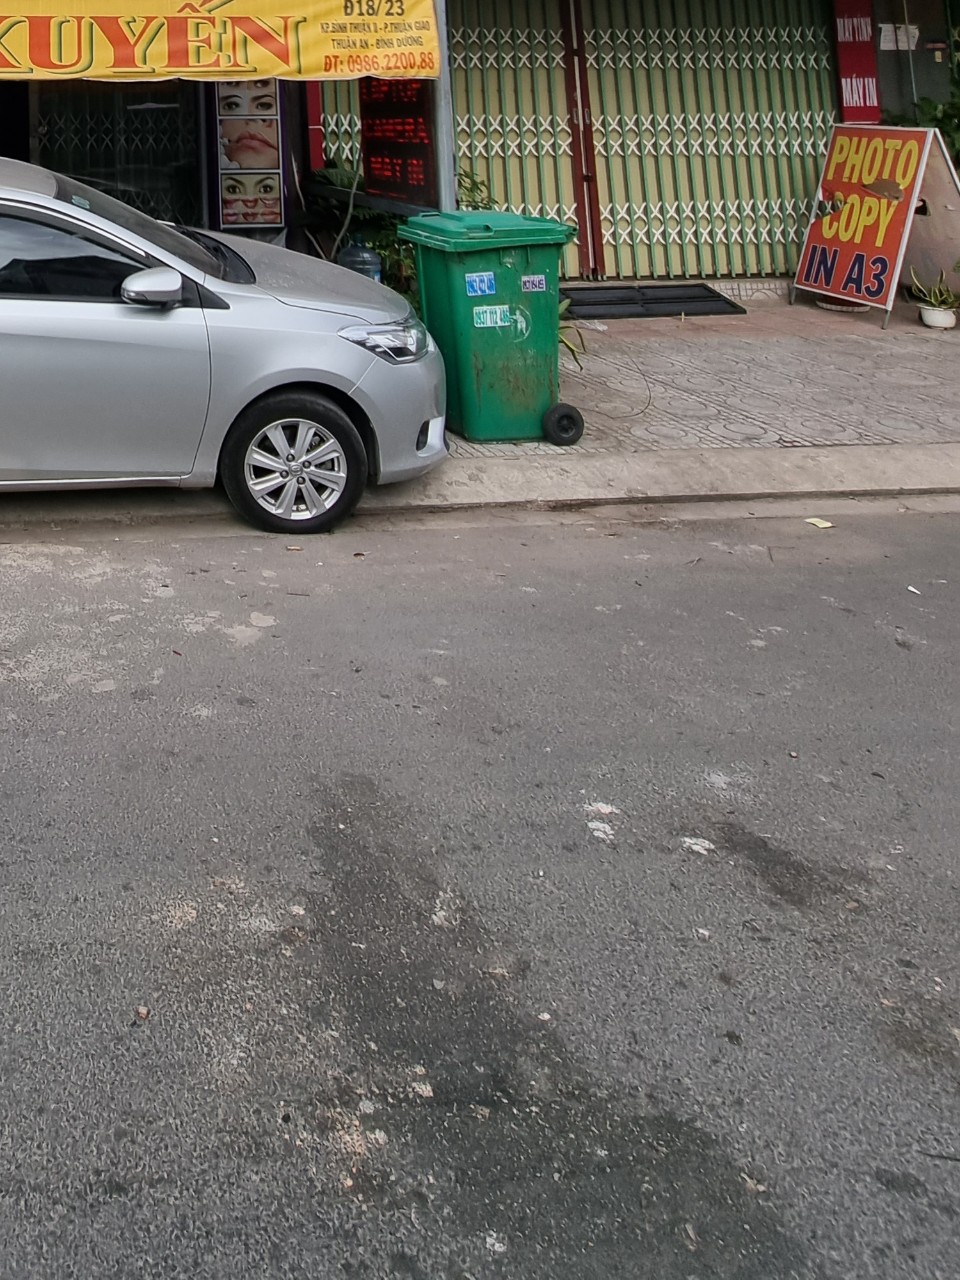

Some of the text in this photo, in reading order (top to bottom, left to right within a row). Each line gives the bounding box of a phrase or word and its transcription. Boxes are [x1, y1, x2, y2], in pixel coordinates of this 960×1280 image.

[323, 52, 435, 72] ĐT: 0986.2200.88
[841, 74, 879, 107] MÁY IN
[827, 136, 919, 188] PHOTO
[802, 244, 889, 299] IN A3
